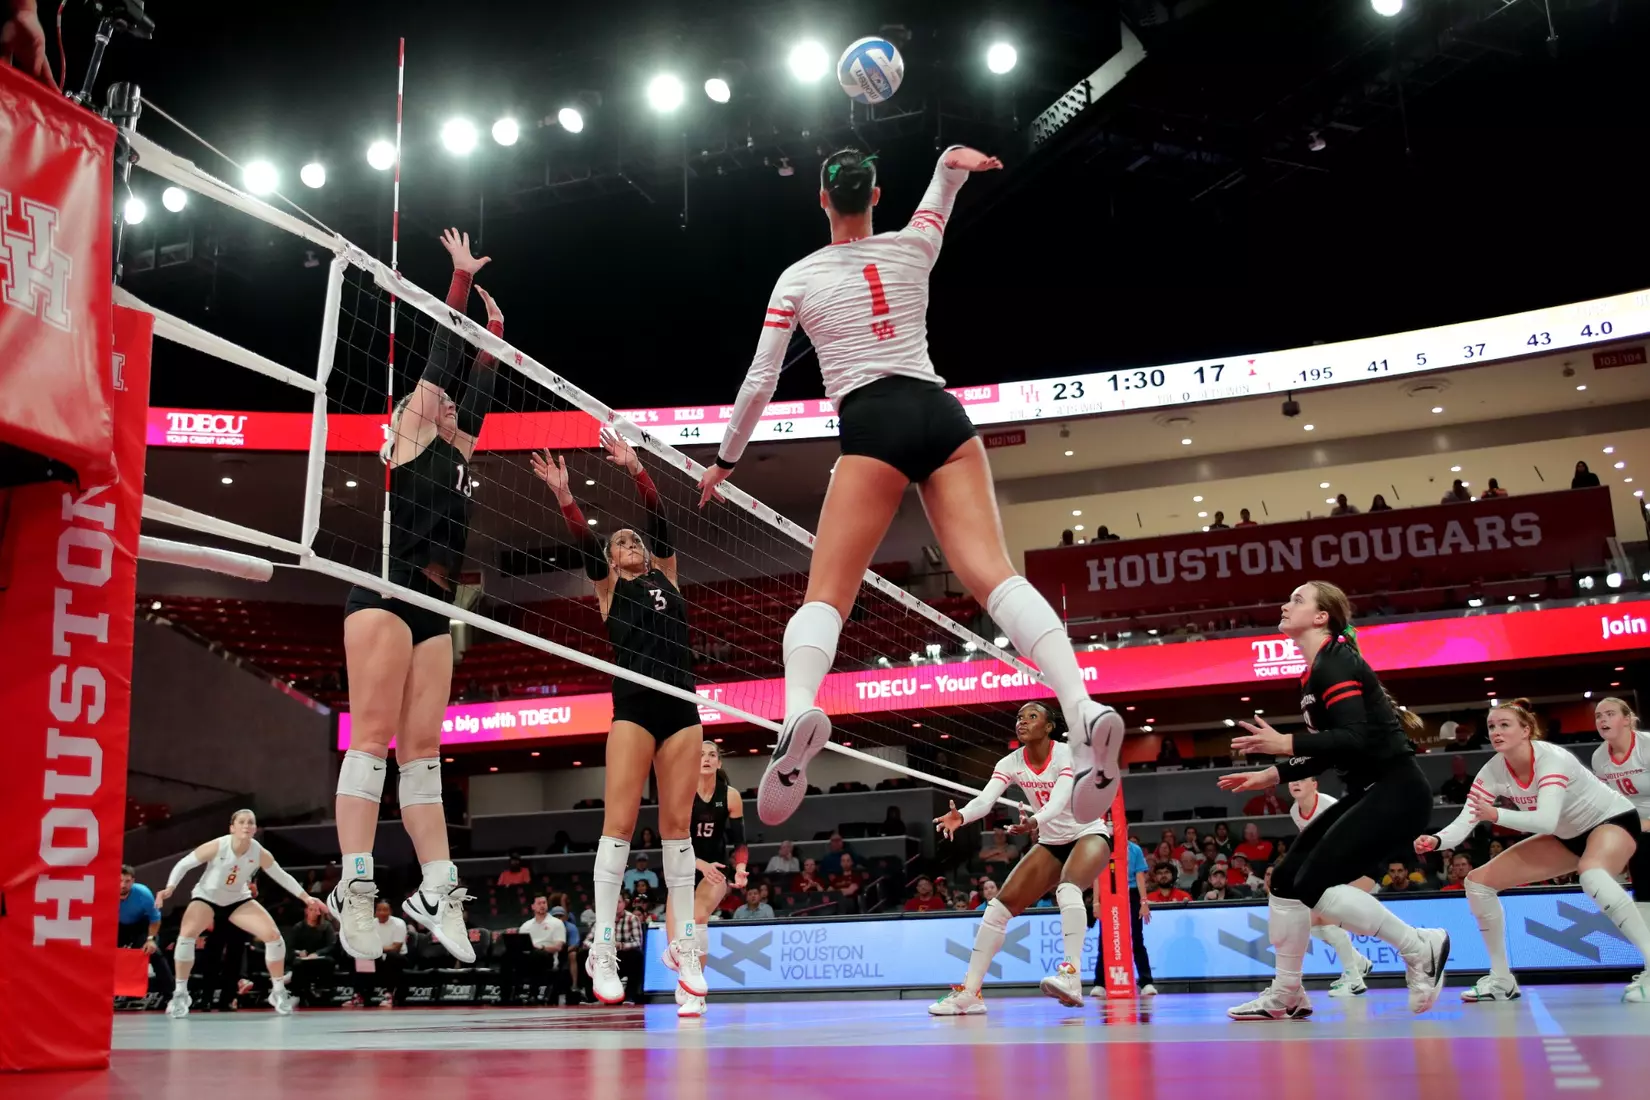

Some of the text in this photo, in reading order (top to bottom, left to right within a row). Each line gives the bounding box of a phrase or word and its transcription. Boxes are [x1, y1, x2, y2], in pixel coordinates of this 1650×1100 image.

[862, 263, 889, 316] 1
[1580, 321, 1613, 337] 4.0
[1527, 332, 1551, 346] 43
[1416, 352, 1427, 366] 5
[1463, 343, 1486, 358] 37
[1194, 364, 1225, 384] 17
[1367, 359, 1389, 372] 41
[1107, 370, 1165, 391] 1:30
[1293, 366, 1333, 384] .195
[1053, 381, 1085, 401] 23
[1182, 392, 1190, 401] 0
[674, 408, 704, 420] KILLS
[1035, 409, 1042, 417] 2
[167, 412, 248, 434] TDECU
[773, 421, 793, 433] 42
[680, 426, 700, 438] 44
[1086, 512, 1542, 592] HOUSTON COUGARS
[648, 589, 668, 611] 3
[1602, 614, 1647, 640] Join
[1252, 638, 1305, 663] TDE
[1253, 667, 1279, 677] YOUR
[856, 678, 917, 699] TDECU
[935, 675, 978, 694] Your
[981, 669, 1036, 689] Credi
[33, 487, 117, 947] HOUSTON
[455, 714, 480, 734] big
[481, 711, 516, 730] with
[518, 707, 571, 727] TDECU
[1020, 780, 1057, 789] HOUSTO
[1616, 777, 1639, 796] 18
[696, 822, 715, 837] 15
[226, 873, 237, 886] 8
[1041, 920, 1063, 936] LO
[781, 944, 864, 962] HOUSTON
[780, 963, 885, 980] VOLLEYBALL
